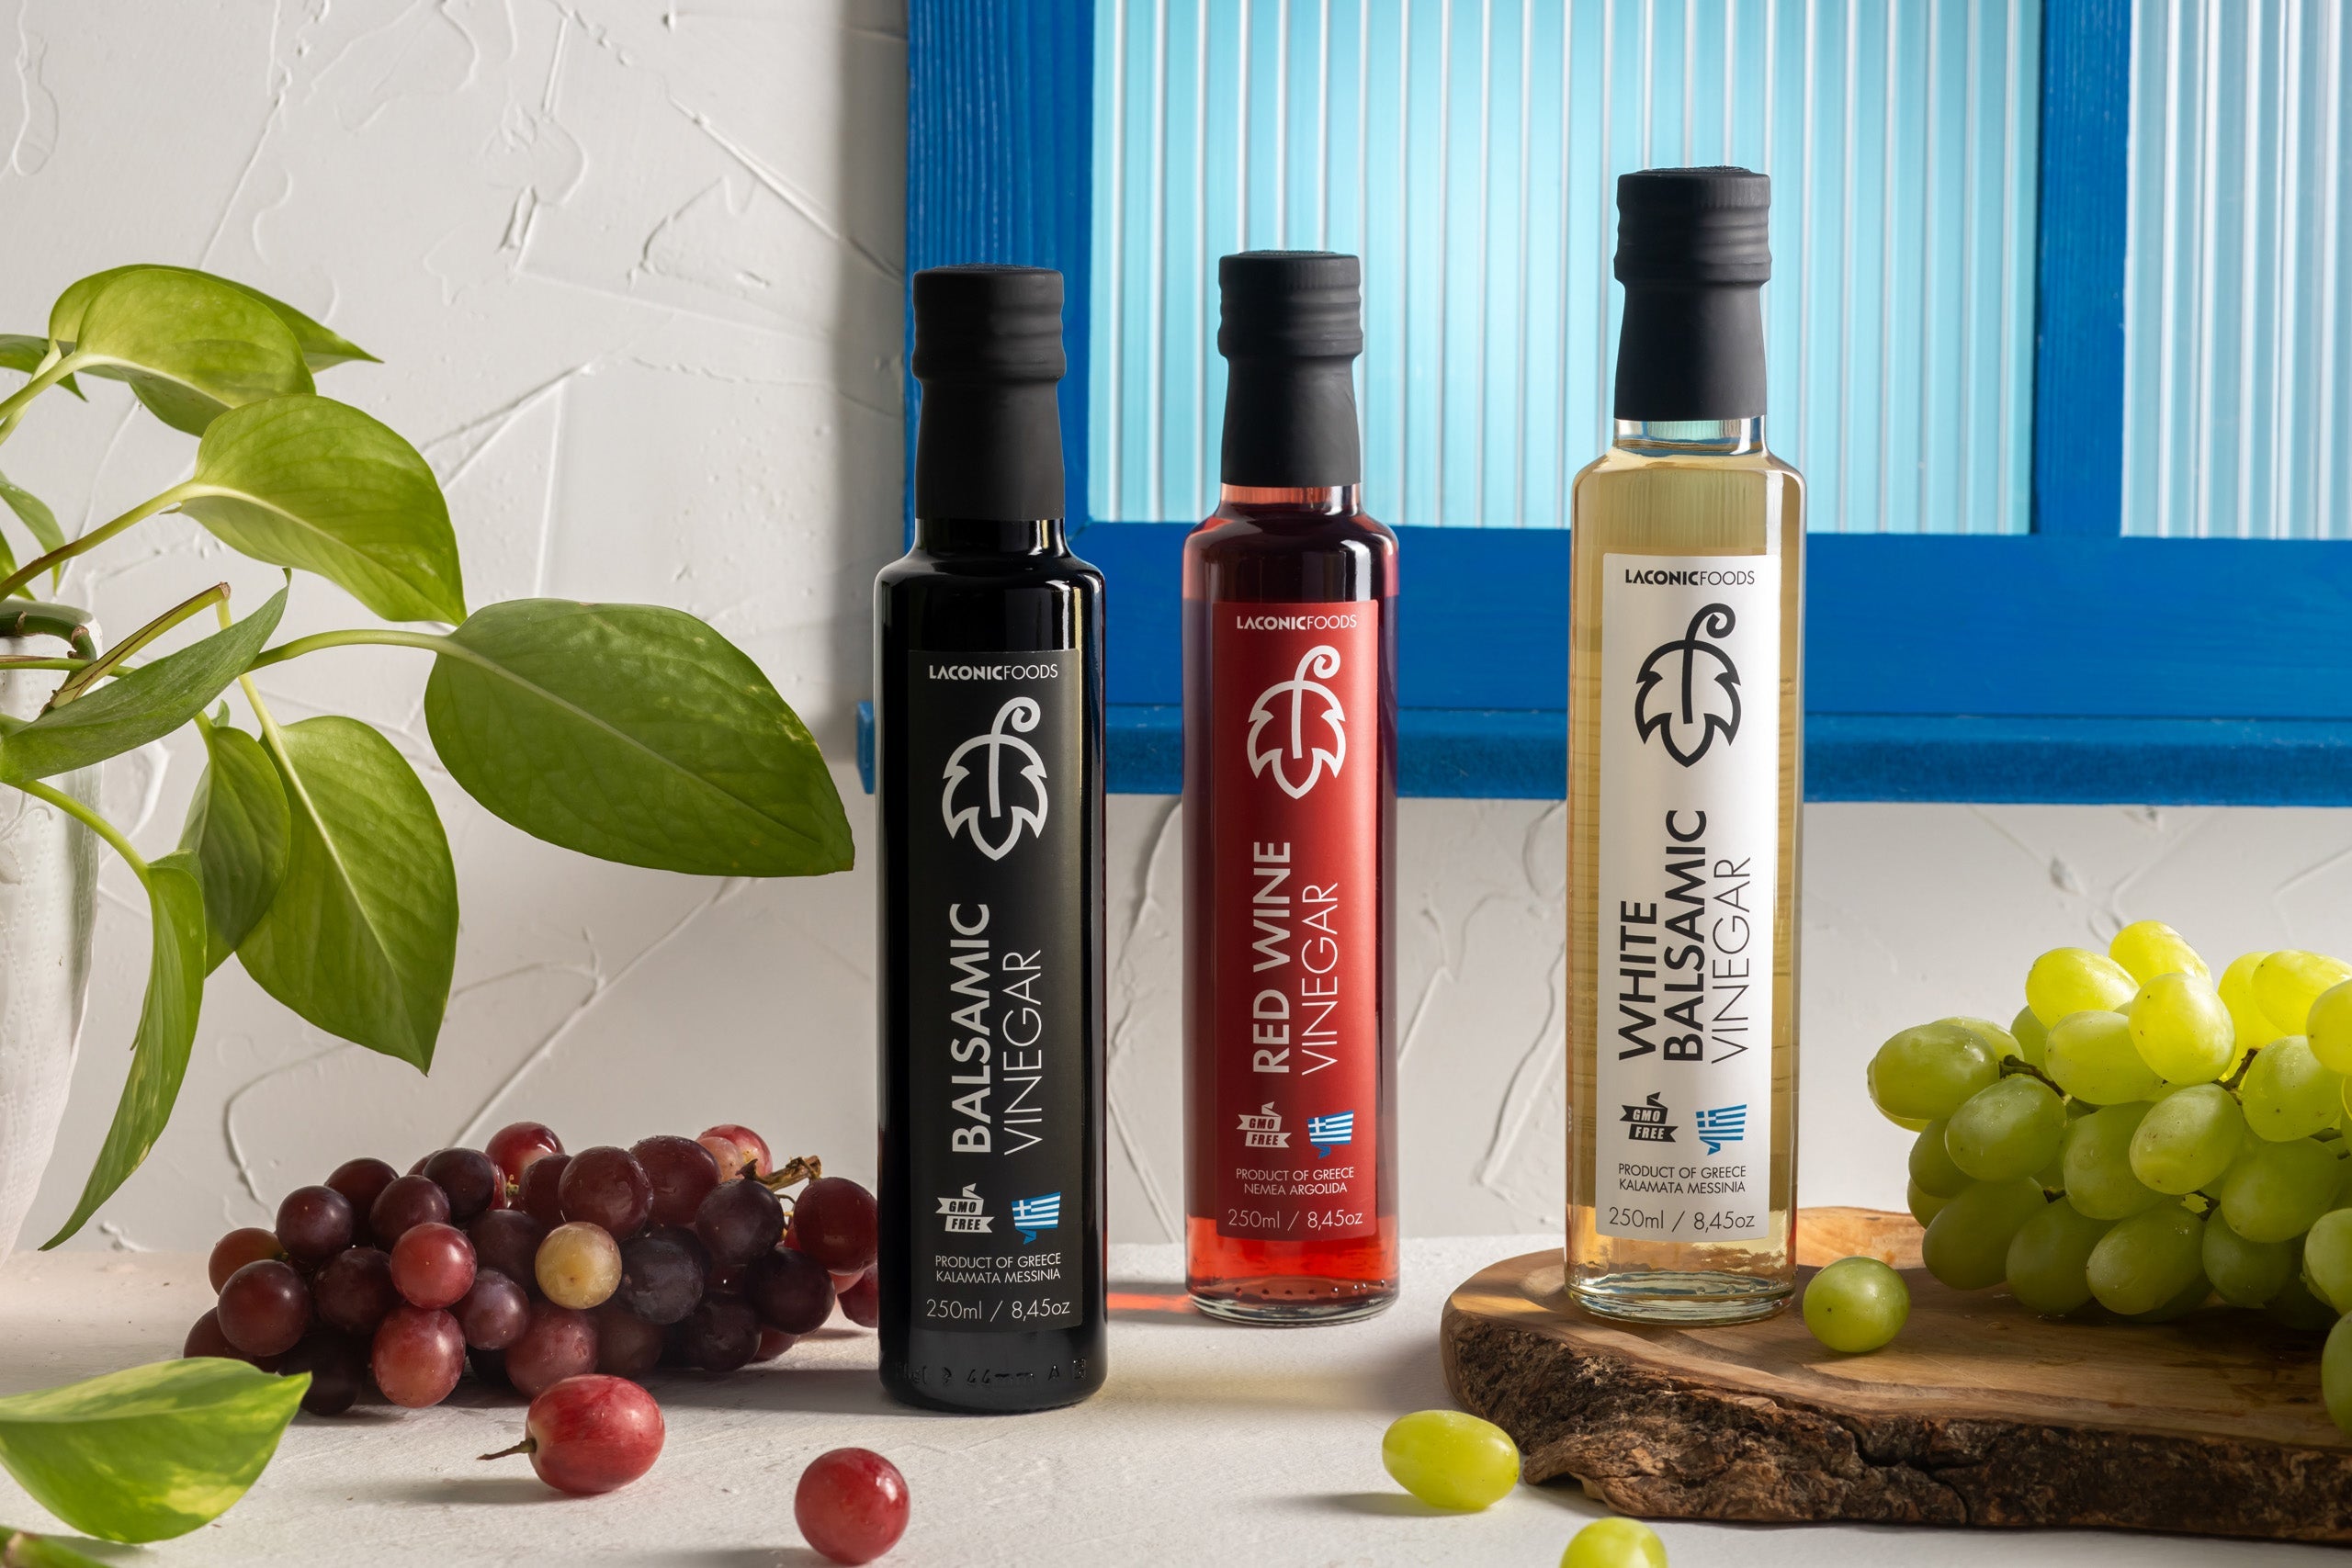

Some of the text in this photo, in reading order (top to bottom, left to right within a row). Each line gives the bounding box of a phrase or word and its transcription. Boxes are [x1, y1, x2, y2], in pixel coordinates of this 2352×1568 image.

[1664, 810, 1707, 1061] BALSAMIC
[1252, 842, 1291, 1074] RED WINE
[1712, 857, 1751, 1064] VINEGAR
[1301, 883, 1338, 1076] VINEGAR
[1618, 900, 1657, 1060] WHITE
[949, 904, 991, 1153] BALSAMIC
[1001, 950, 1043, 1156] VINEGAR
[1249, 1119, 1275, 1129] GMO
[1633, 1110, 1660, 1122] GMO
[1251, 1134, 1279, 1145] FREE
[1635, 1126, 1665, 1139] FREE
[1237, 1167, 1354, 1181] PRODUCT OF GREECE
[1619, 1163, 1746, 1179] PRODUCT OF GREECE
[1244, 1182, 1348, 1195] NEMEA ARGOLIDA
[1619, 1179, 1746, 1194] KALAMATA MESSINIA
[948, 1201, 977, 1213] GMO
[952, 1219, 981, 1230] FREE
[1227, 1209, 1363, 1231] 250ml / 8,45oz
[1609, 1207, 1755, 1233] 250ml / 8,45oz
[935, 1253, 1061, 1269] PRODUCT OF GREECE
[936, 1269, 1061, 1283] KALAMATA MESSINIA
[926, 1298, 1070, 1322] 250ml / 8,45oz
